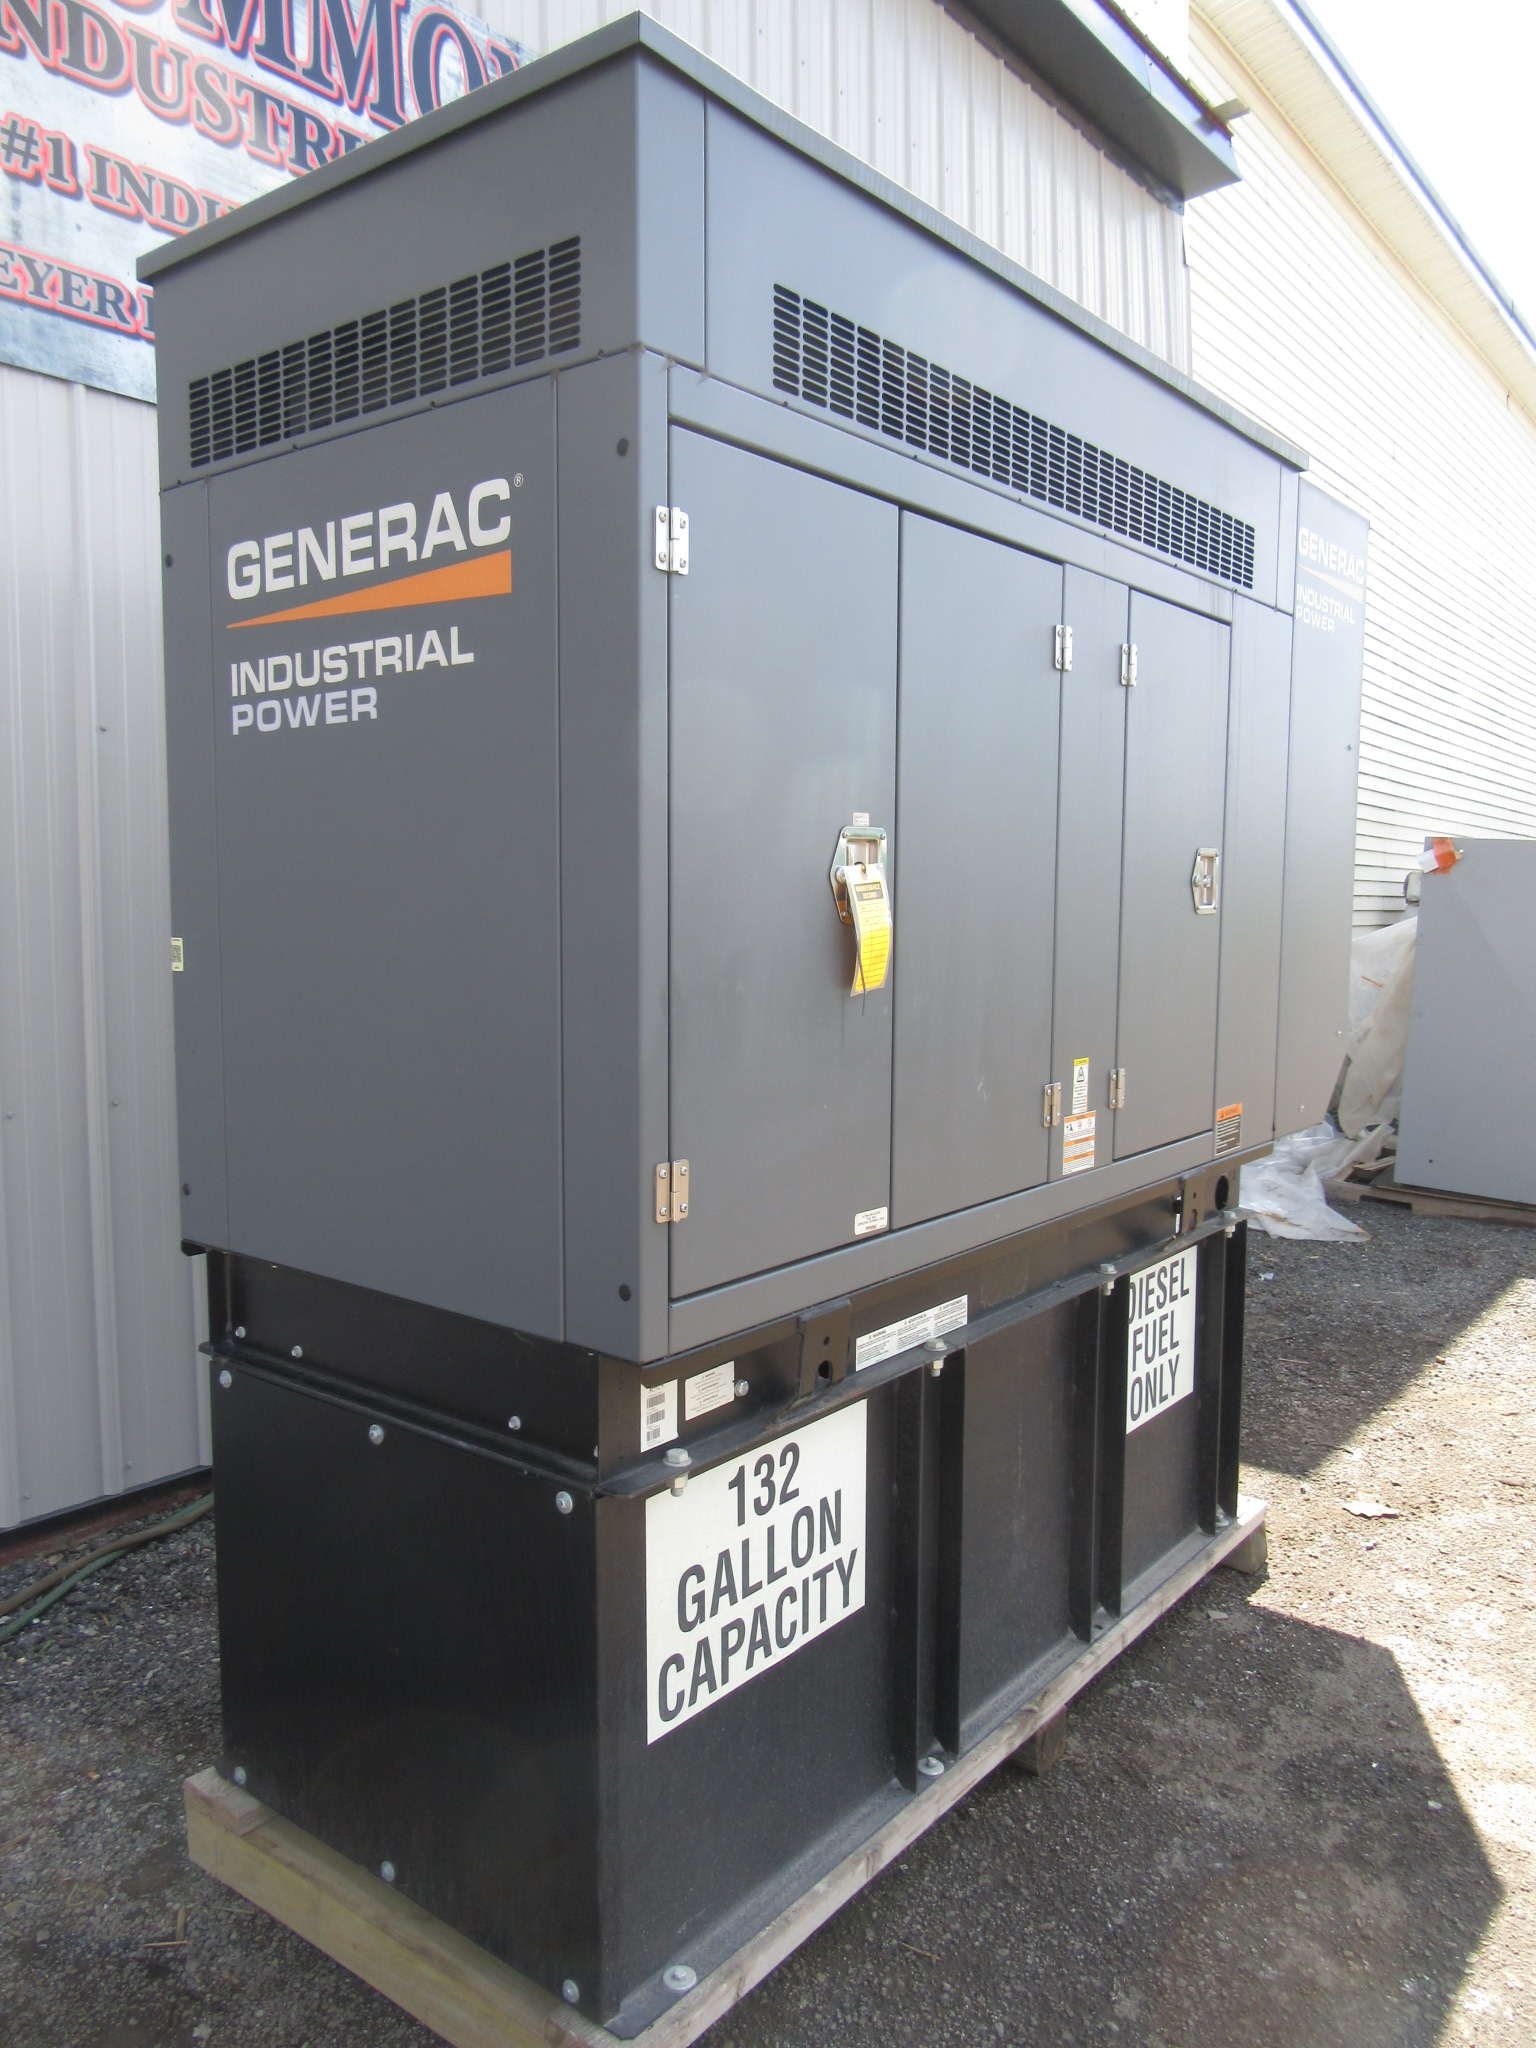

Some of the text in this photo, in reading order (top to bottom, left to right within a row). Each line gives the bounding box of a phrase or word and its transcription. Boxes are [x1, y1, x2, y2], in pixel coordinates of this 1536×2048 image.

[0, 112, 77, 193] #1
[227, 478, 511, 600] GENERAC
[1298, 527, 1365, 585] GENERAC
[1295, 605, 1335, 633] POWER
[1296, 584, 1355, 625] INDUSTRIAL
[230, 626, 475, 697] INDUSTRIAL
[231, 686, 378, 735] POWER
[1132, 1310, 1180, 1372] FUEL
[1130, 1353, 1180, 1422] ONLY
[728, 1442, 800, 1527] 132
[677, 1488, 842, 1633] GALLON
[658, 1547, 858, 1723] CAPACITY
